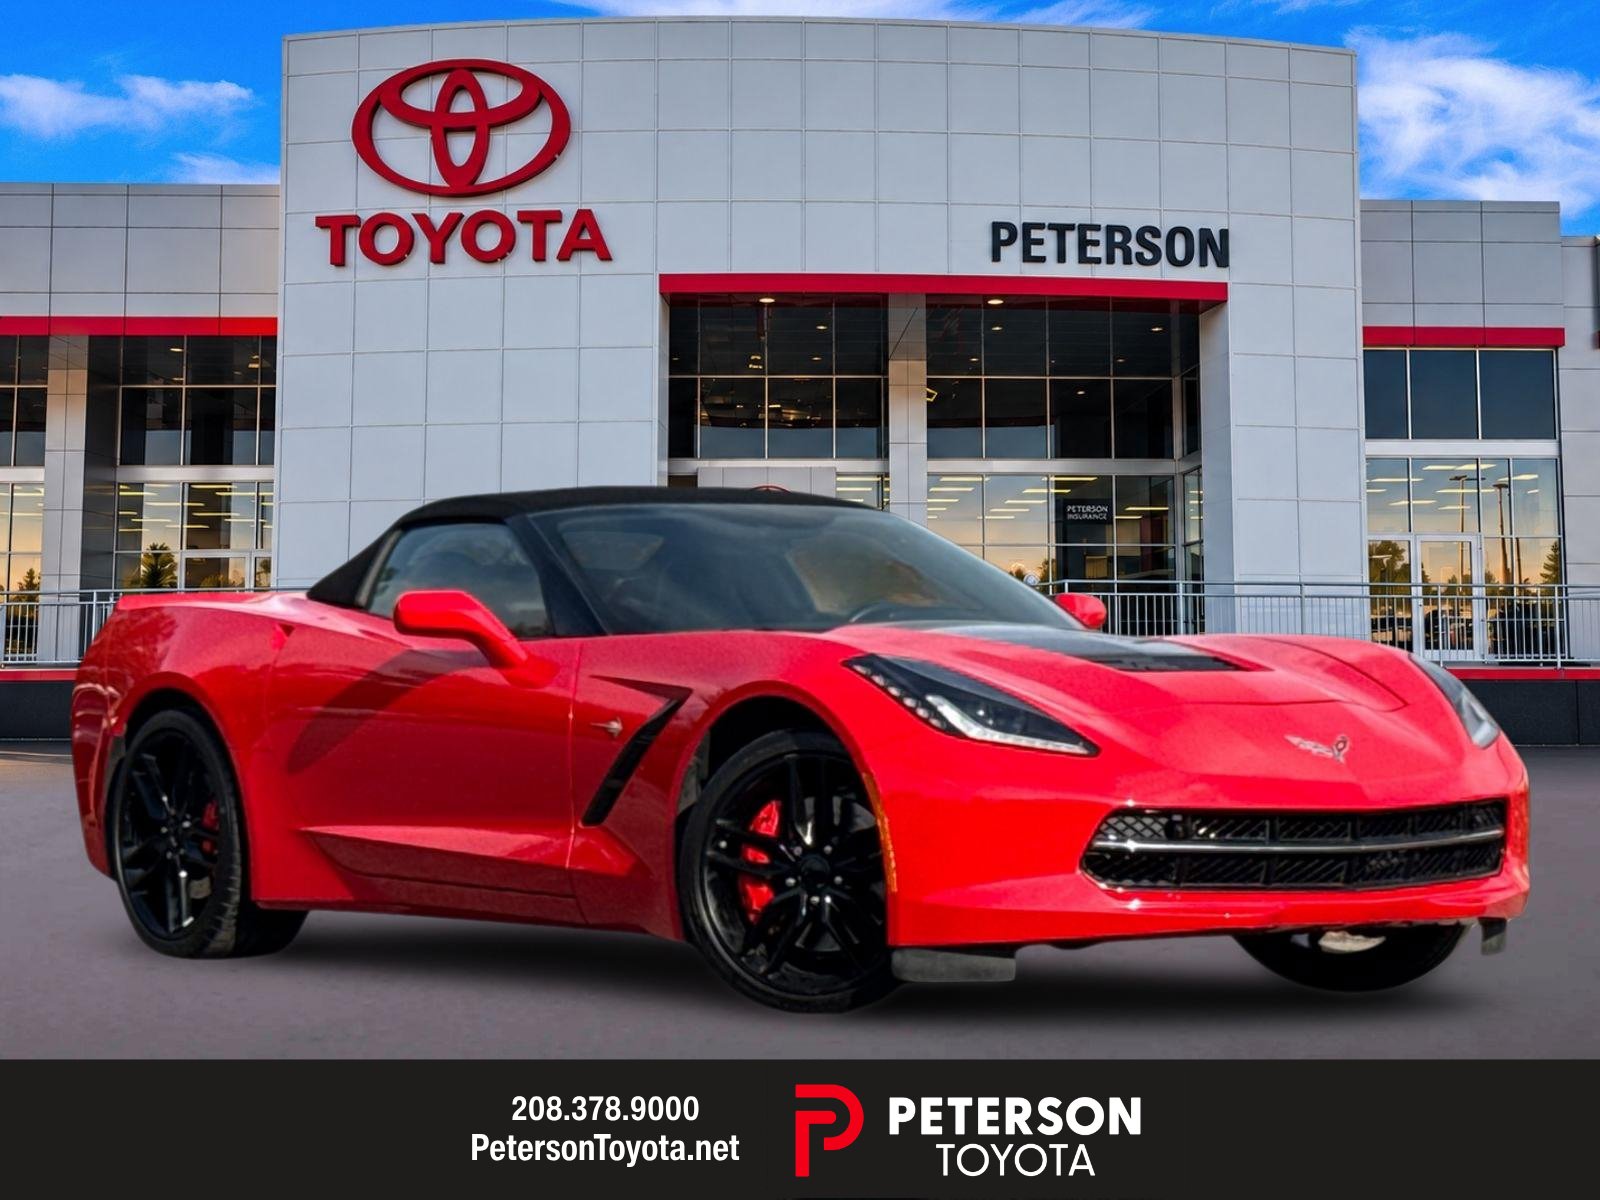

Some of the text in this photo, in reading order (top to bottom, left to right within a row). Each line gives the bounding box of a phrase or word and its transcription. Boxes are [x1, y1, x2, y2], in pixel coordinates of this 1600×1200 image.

[316, 209, 611, 266] TOYOTA
[991, 221, 1230, 269] PETERSON
[1066, 505, 1109, 513] PETERSON
